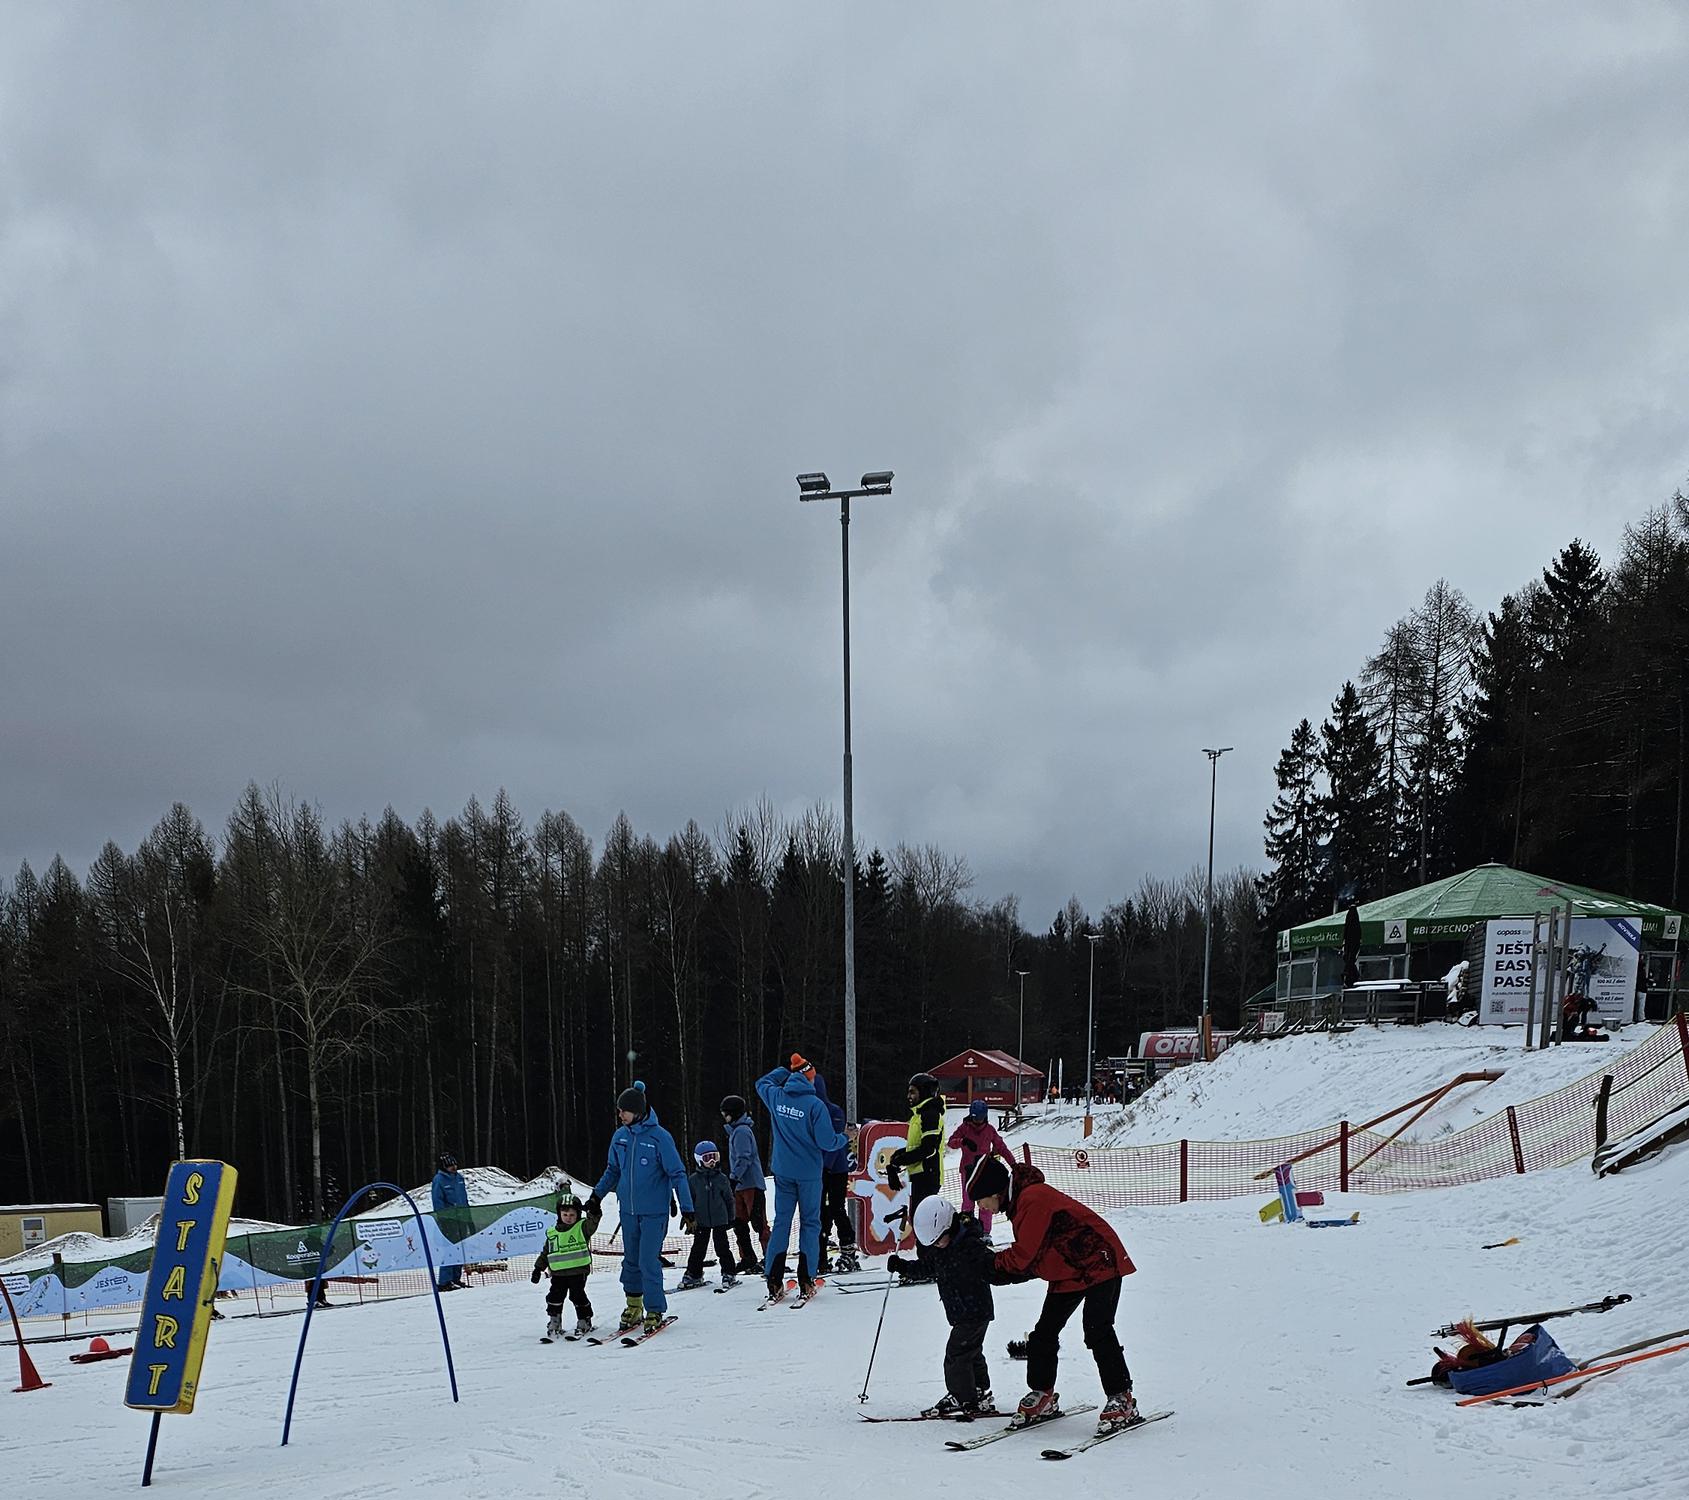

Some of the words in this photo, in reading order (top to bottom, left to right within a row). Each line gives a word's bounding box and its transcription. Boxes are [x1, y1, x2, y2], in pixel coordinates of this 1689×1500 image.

[1495, 960, 1532, 971] EASY
[1493, 976, 1531, 988] PASS
[147, 1171, 205, 1396] START
